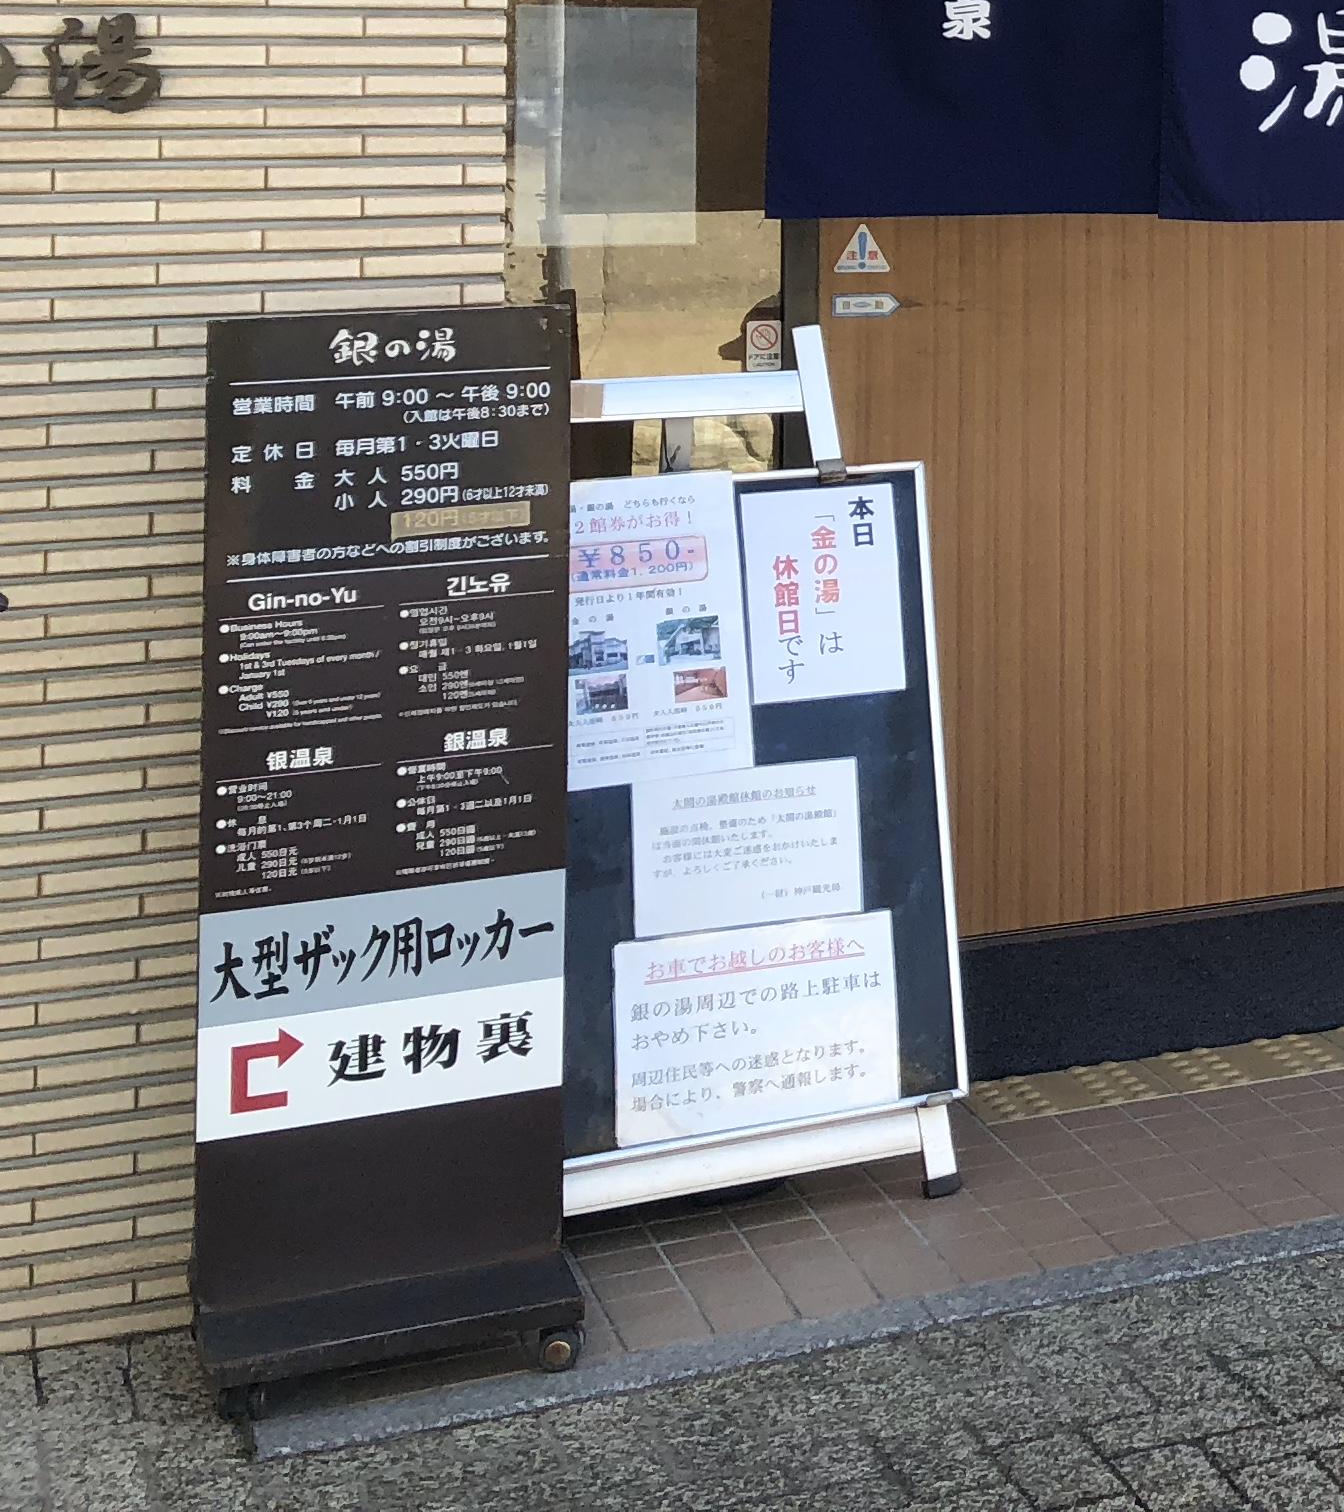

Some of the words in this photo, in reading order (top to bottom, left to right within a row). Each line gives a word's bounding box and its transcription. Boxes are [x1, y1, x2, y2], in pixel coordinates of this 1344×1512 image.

[0, 13, 162, 113] 湯
[329, 327, 457, 366] 銀の湯
[232, 394, 315, 416] 営業時間
[335, 392, 375, 409] 午前
[381, 389, 428, 407] 9:00
[461, 384, 499, 403] 午後
[506, 382, 550, 400] 9:00
[231, 441, 315, 464] 定休日
[334, 466, 388, 488] 大人
[401, 462, 459, 482] 550円
[334, 490, 388, 511] 小人
[400, 486, 459, 506] 290円
[848, 496, 875, 548] 本日
[248, 587, 357, 612] Gin-no-Yu
[447, 573, 511, 596] 긴노유
[811, 512, 845, 655] 「金の湯」は
[772, 554, 805, 685] 休館日です
[266, 747, 333, 771] 银温泉
[210, 908, 555, 1003] 大型ザック用ロッカー
[646, 937, 864, 982] お車でお越しのお客様へ
[630, 970, 882, 1022] 銀の湯周辺での路上駐車は
[328, 1010, 534, 1087] 建物裏
[631, 1019, 758, 1051] おやめ下さい。
[631, 1039, 866, 1088] 周辺住民等への迷惑となります。
